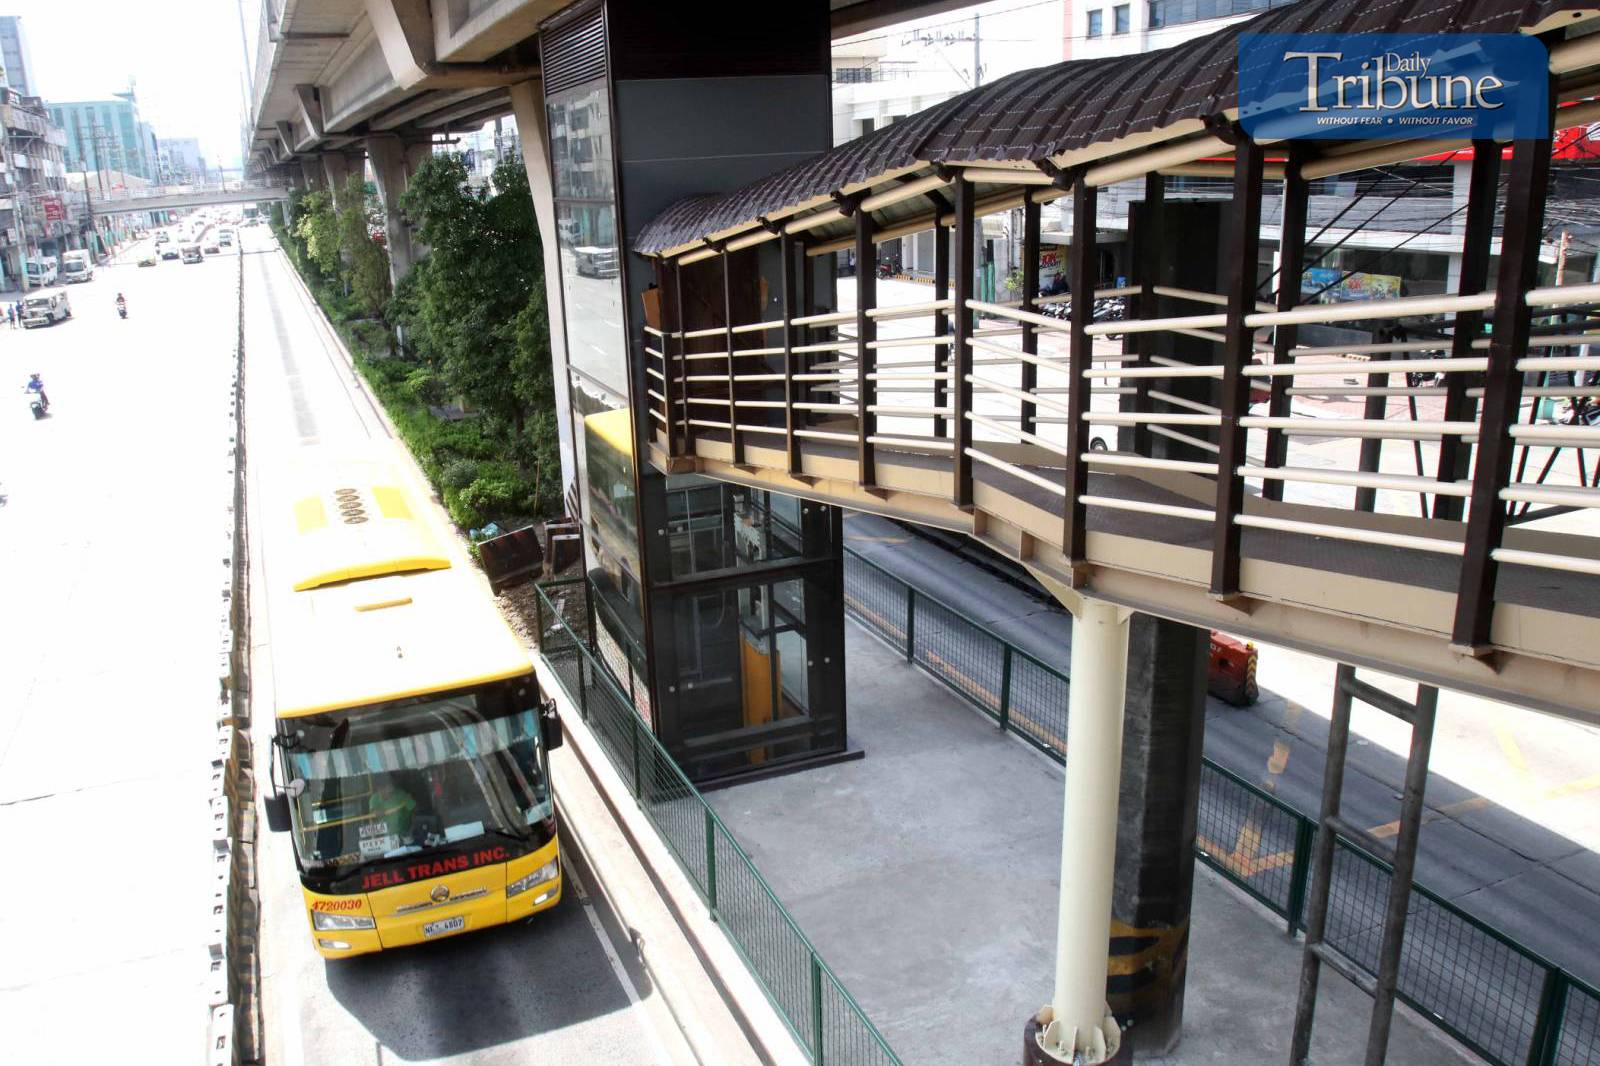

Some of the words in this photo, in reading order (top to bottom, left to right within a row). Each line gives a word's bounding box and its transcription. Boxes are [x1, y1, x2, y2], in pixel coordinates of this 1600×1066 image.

[363, 871, 405, 889] JELL
[408, 855, 468, 880] TRANS
[473, 847, 511, 865] INC.
[312, 899, 362, 912] 4720030
